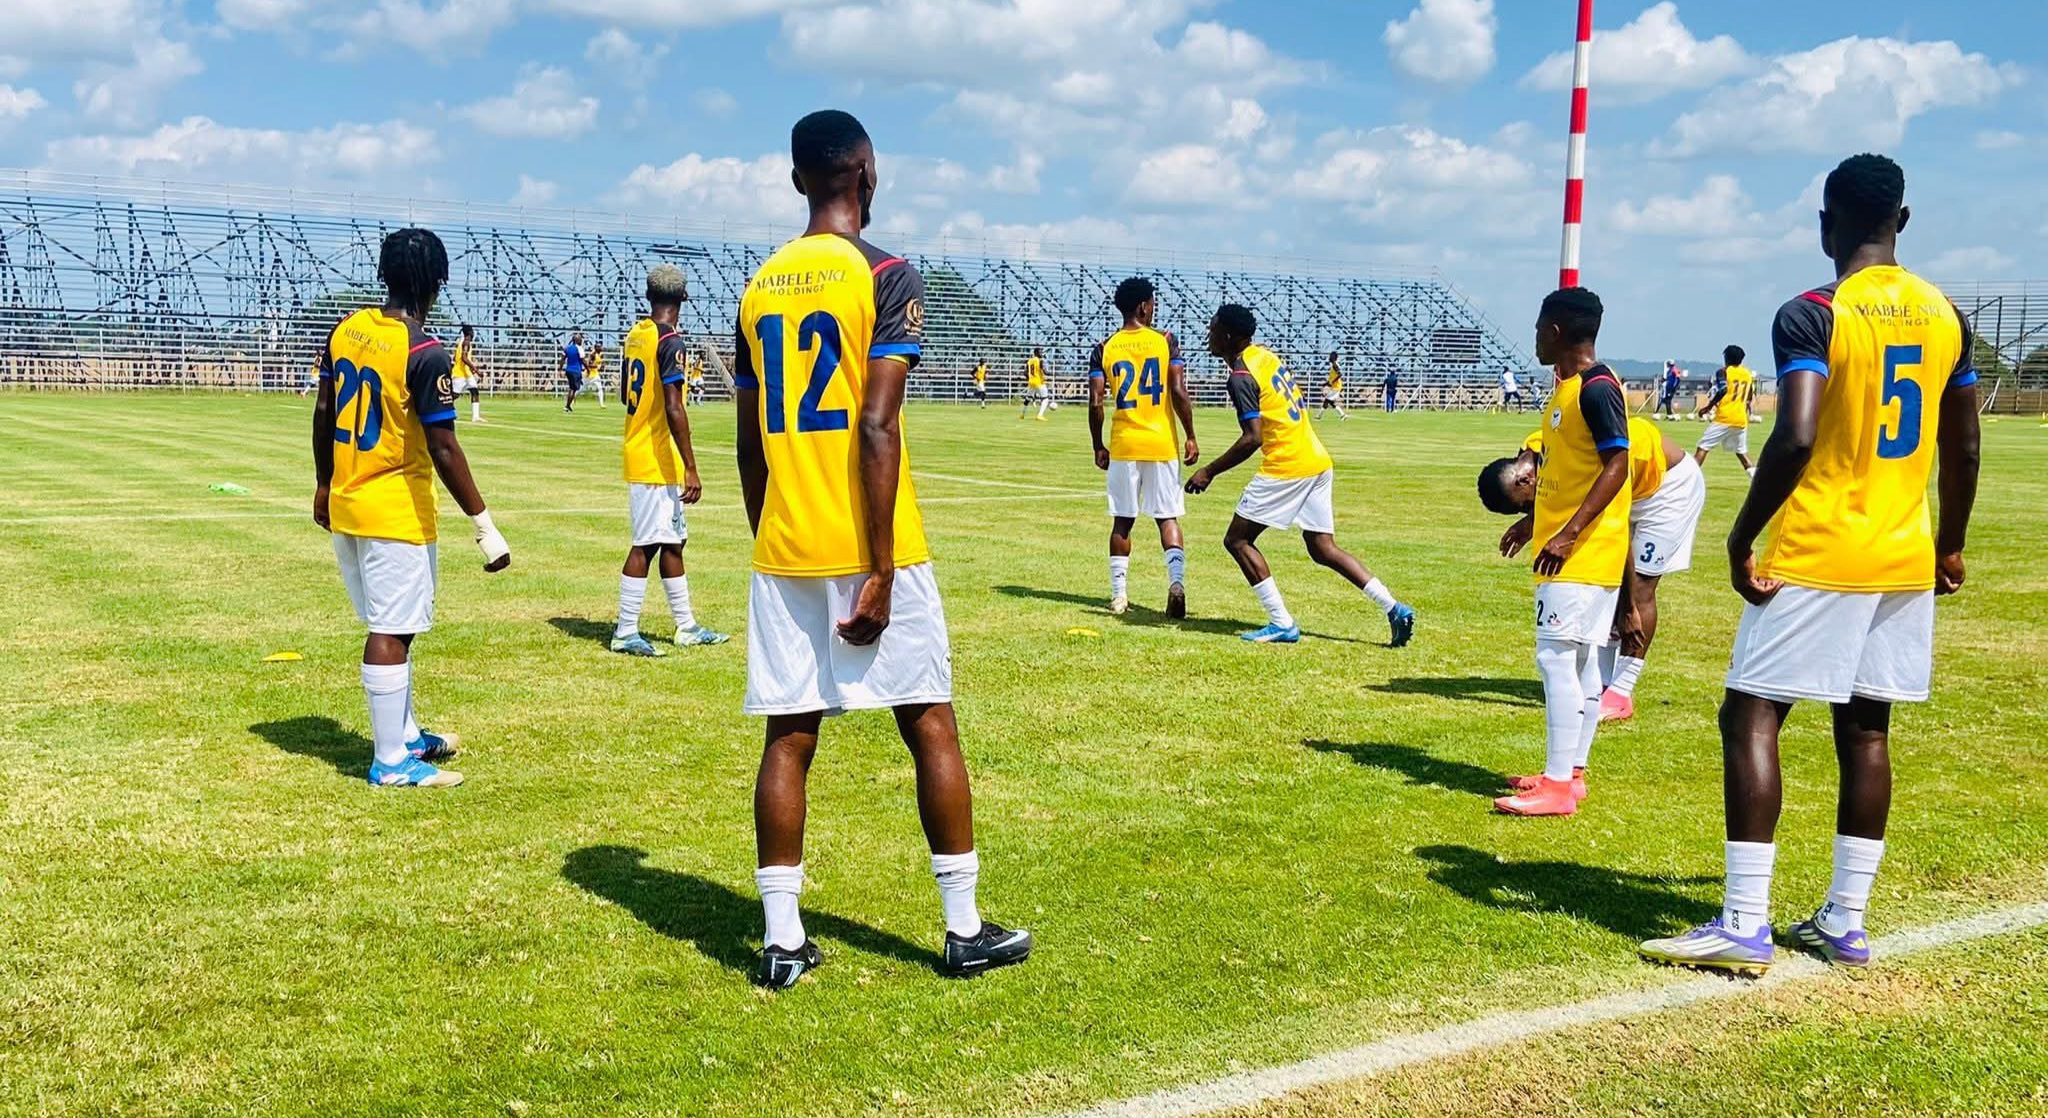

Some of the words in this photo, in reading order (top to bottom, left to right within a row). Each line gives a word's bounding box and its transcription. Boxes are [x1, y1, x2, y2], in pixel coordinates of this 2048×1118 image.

[755, 270, 813, 293] MABELE
[769, 284, 825, 296] HOLDINGS
[1879, 318, 1930, 327] HOLINGS
[754, 310, 849, 434] 12
[1112, 357, 1164, 410] 24
[334, 356, 383, 452] 20
[1877, 344, 1922, 459] 5
[1639, 541, 1656, 563] 3
